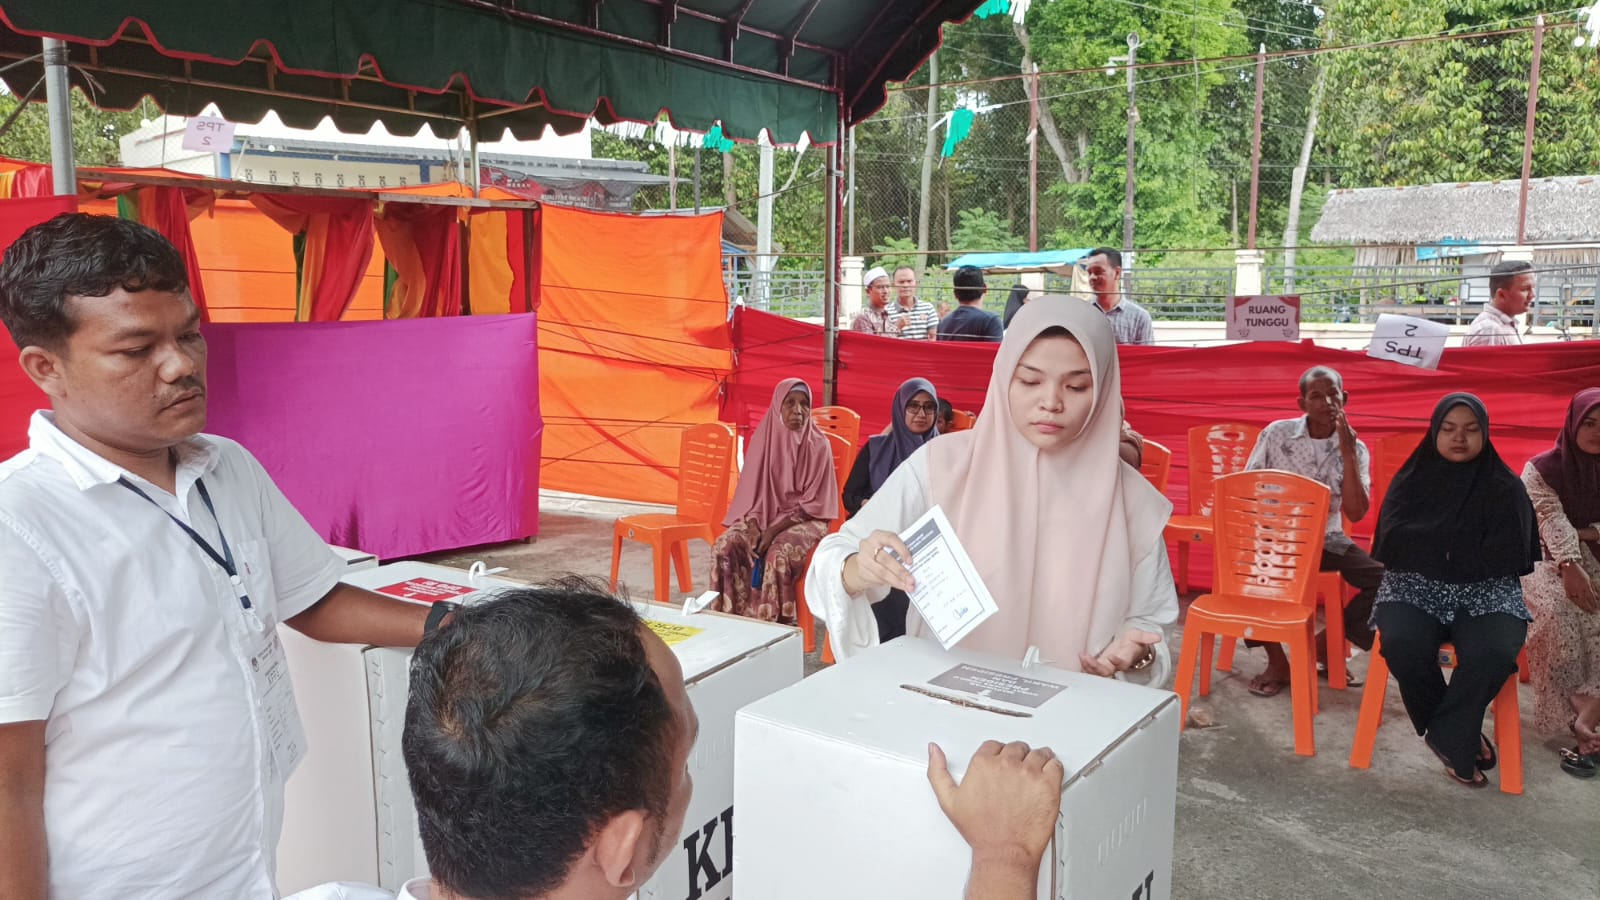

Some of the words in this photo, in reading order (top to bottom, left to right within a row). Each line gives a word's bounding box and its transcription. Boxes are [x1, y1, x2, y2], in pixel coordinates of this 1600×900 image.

[1248, 305, 1287, 314] RUANG
[1245, 318, 1289, 327] TUNGGU
[1405, 323, 1418, 337] 2
[1384, 340, 1424, 360] TPS
